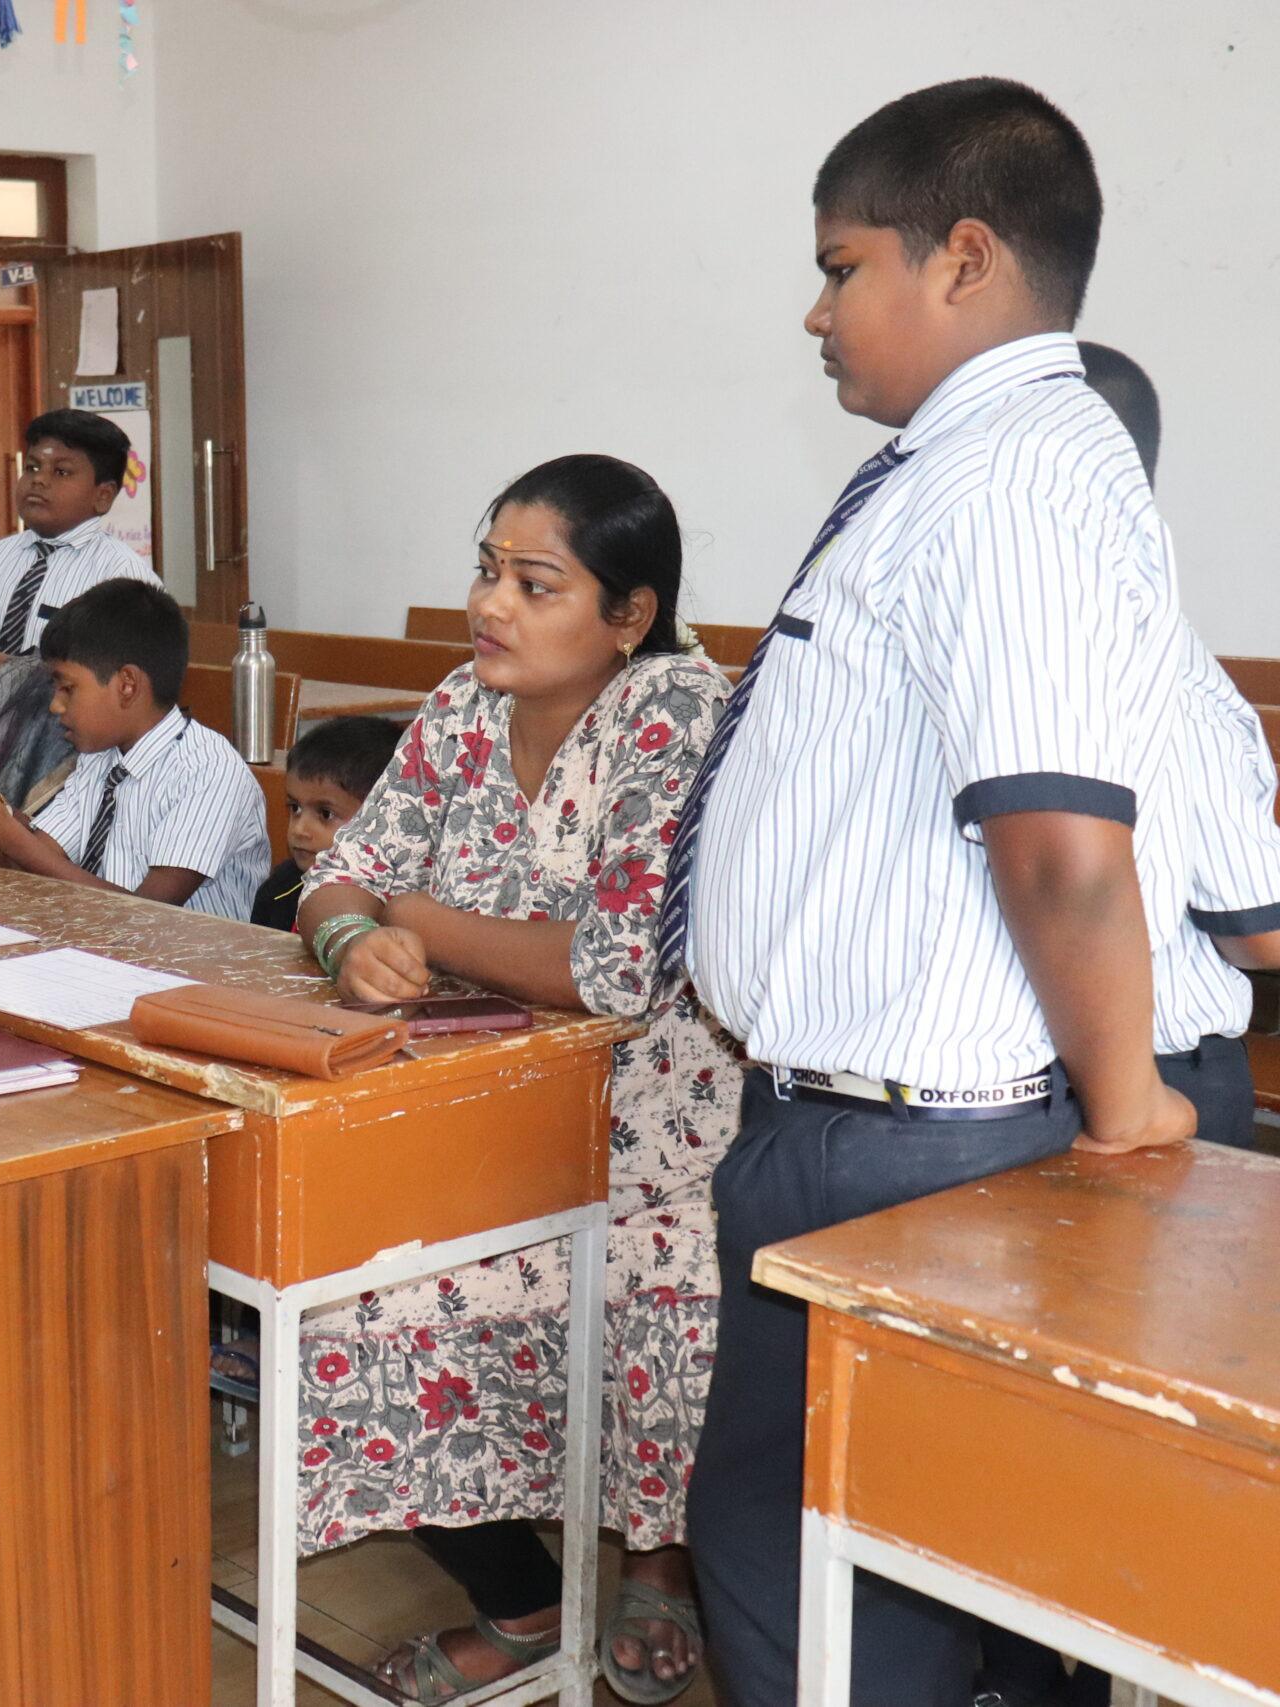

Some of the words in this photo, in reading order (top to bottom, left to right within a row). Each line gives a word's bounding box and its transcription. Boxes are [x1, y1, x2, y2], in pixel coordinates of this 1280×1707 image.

[7, 265, 34, 284] V-B
[75, 386, 142, 409] WELCOME
[793, 1067, 834, 1088] CHOOL
[920, 1088, 1005, 1104] OXFORD
[1012, 1079, 1049, 1099] ENG
